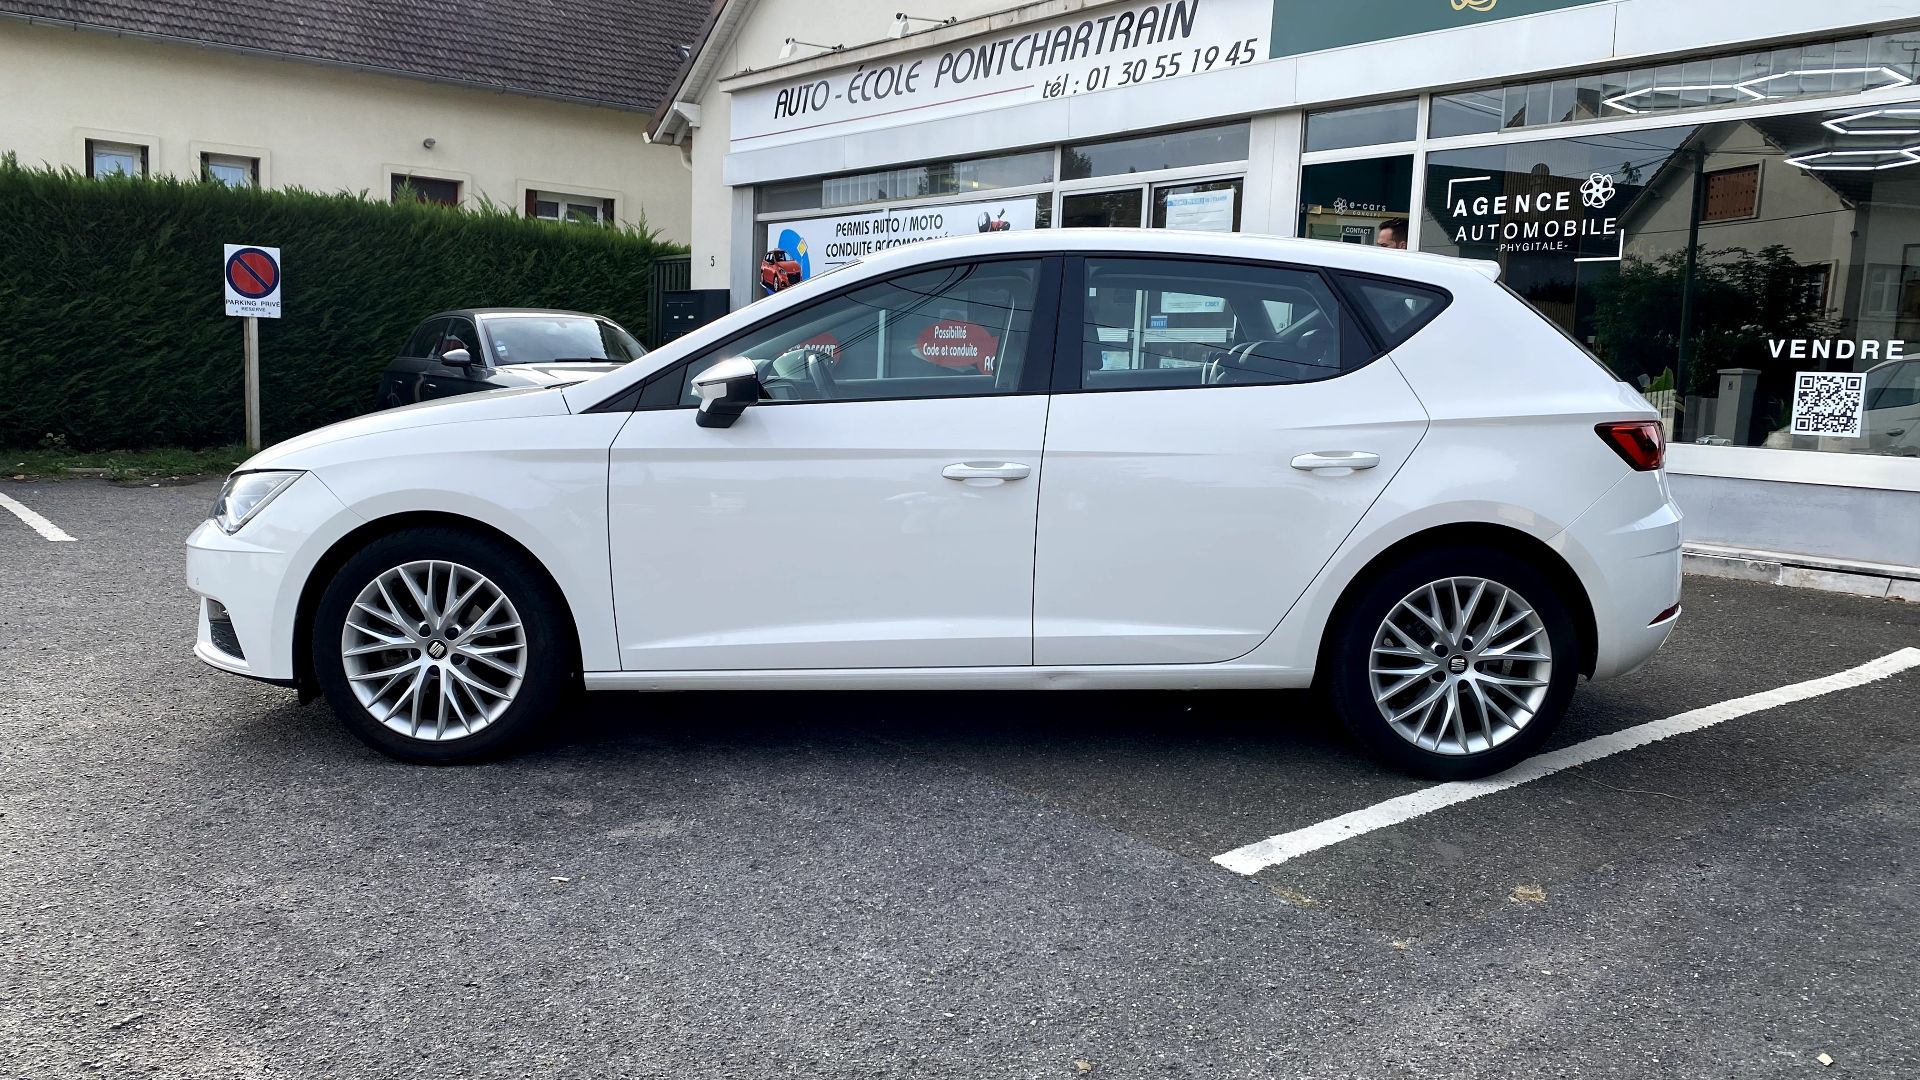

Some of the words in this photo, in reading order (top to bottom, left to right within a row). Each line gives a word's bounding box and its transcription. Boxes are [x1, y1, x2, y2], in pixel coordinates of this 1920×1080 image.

[773, 79, 831, 120] AUTO
[847, 60, 923, 104] ÉCOLE
[933, 0, 1199, 89] PONTCHARTRAIN
[1042, 73, 1070, 99] tél
[1086, 65, 1111, 92] 01
[1117, 58, 1148, 86] 30
[1151, 52, 1183, 80] 55
[1191, 45, 1220, 73] 19
[1225, 38, 1259, 66] 45
[1349, 201, 1387, 212] e-cars
[1452, 191, 1571, 218] AGENCE
[835, 220, 870, 238] PERMIS
[873, 217, 900, 235] AUTO
[909, 213, 944, 232] MOTO
[1345, 227, 1371, 235] CONTACT
[1454, 218, 1618, 242] AUTOMOBILE
[825, 240, 872, 258] CONDUITE
[710, 255, 715, 267] 5
[934, 325, 967, 339] Possibilité
[922, 342, 940, 356] Code
[940, 344, 948, 356] et
[949, 342, 978, 357] conduite
[1768, 339, 1905, 360] VENDRE
